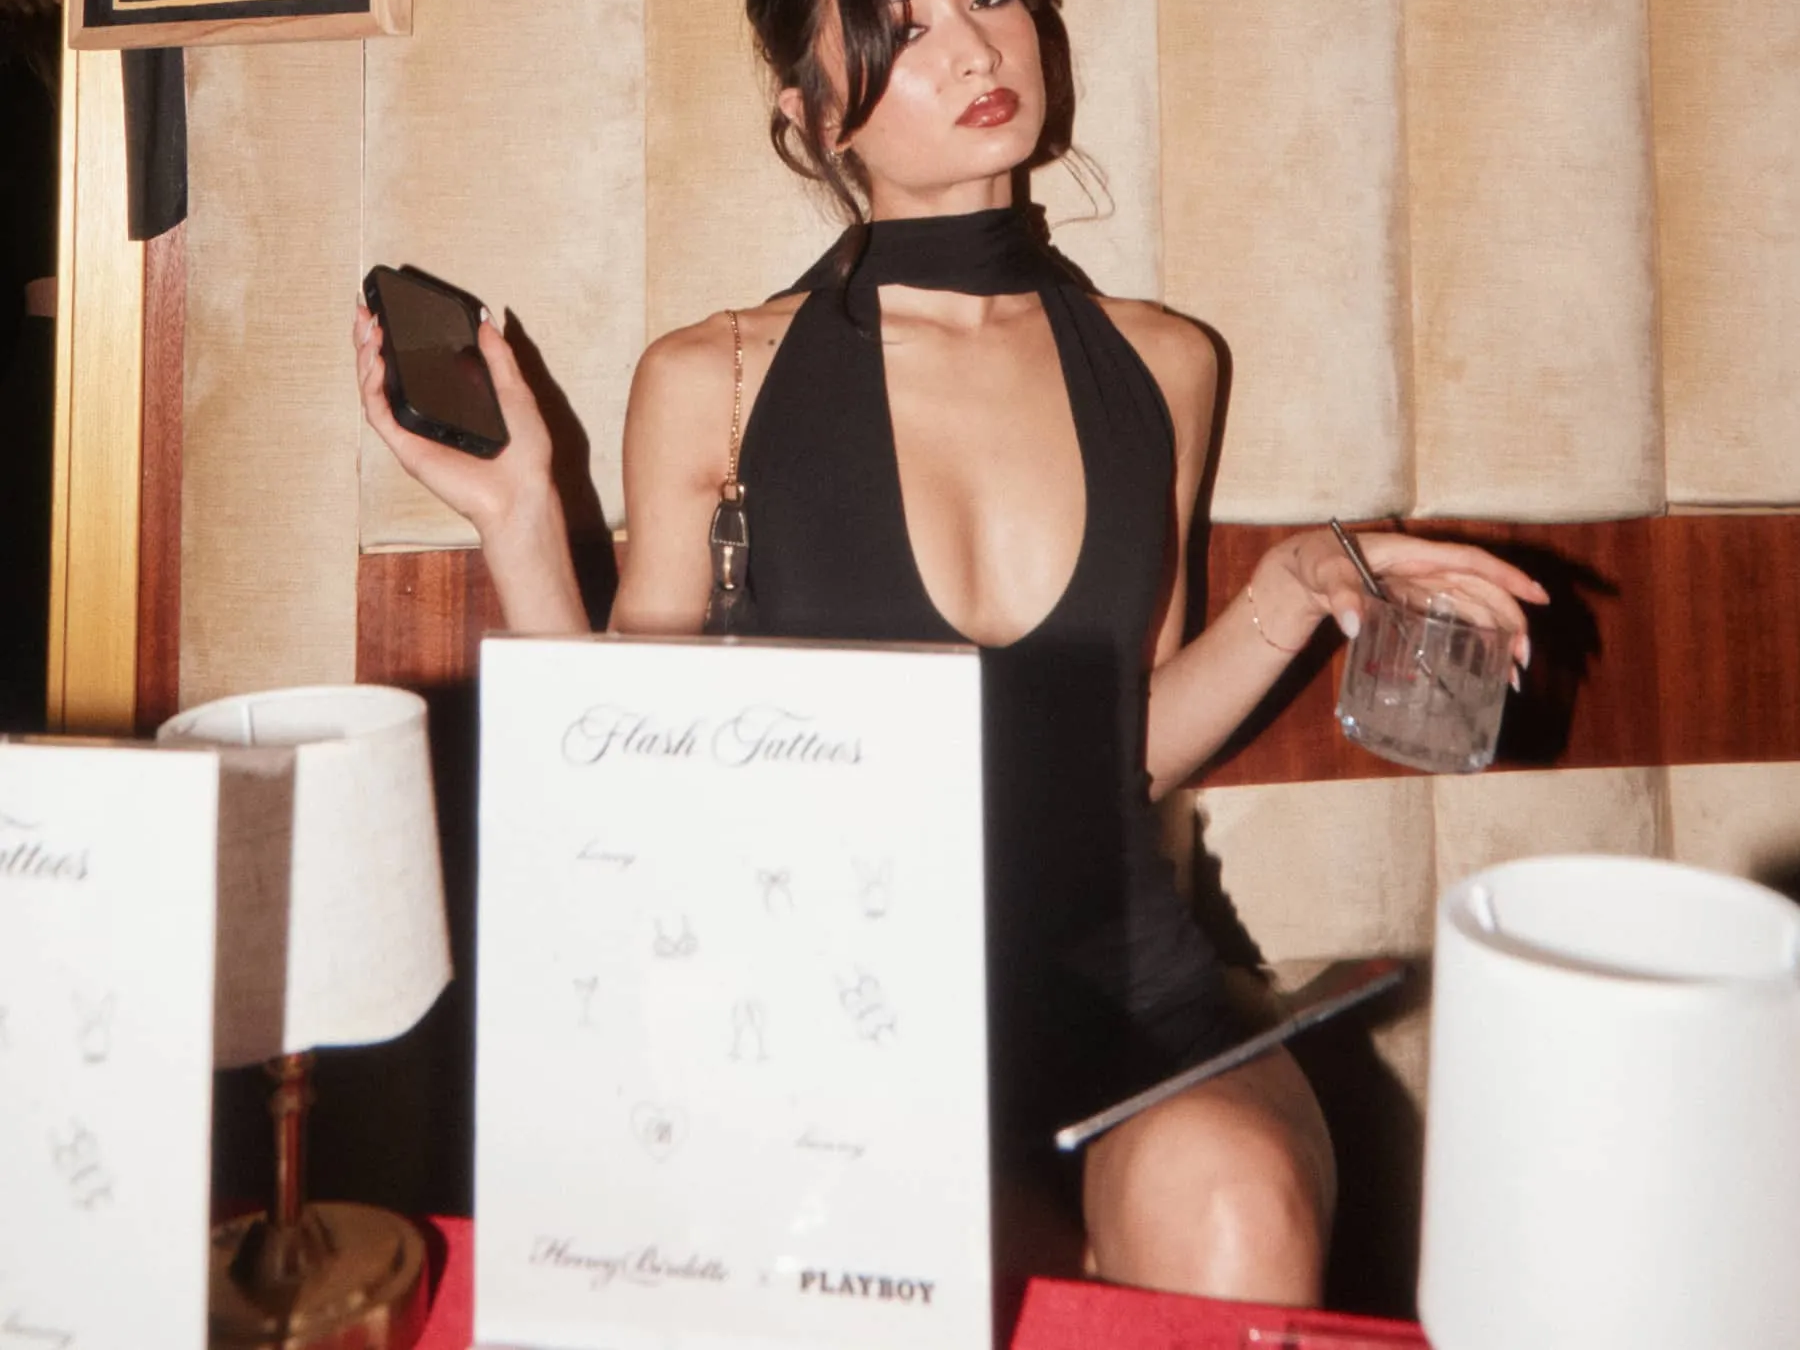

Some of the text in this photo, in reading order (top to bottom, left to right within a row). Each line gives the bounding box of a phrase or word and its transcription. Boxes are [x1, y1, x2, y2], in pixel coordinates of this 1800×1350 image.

[560, 705, 863, 768] Flash Tattoos
[797, 1267, 938, 1308] PLAYBOY
